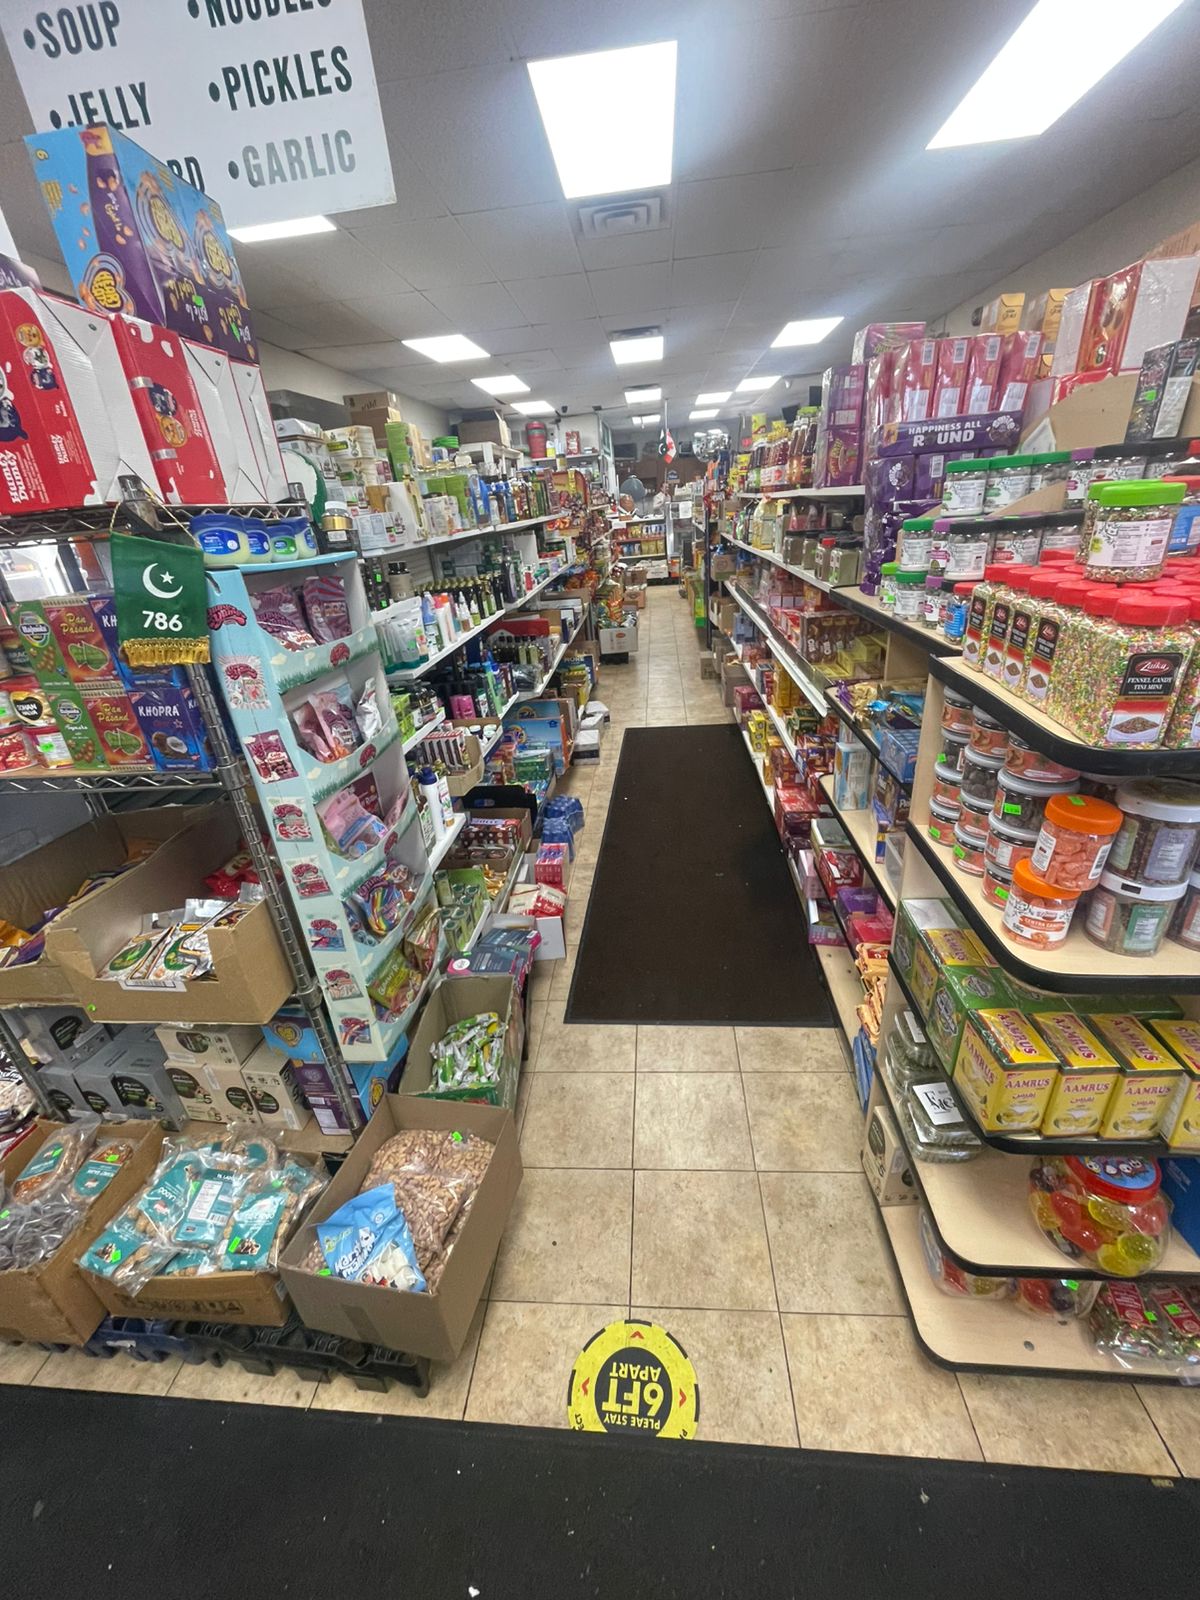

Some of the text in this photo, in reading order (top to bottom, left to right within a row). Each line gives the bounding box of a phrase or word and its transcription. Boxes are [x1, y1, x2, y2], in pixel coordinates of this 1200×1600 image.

[36, 1, 120, 59] SOUP
[222, 45, 353, 111] PICKLES
[242, 129, 356, 189] GARLIC
[908, 420, 982, 435] HAPPINESS ALL
[4, 449, 29, 501] Dumty
[65, 612, 86, 625] Pan
[142, 609, 183, 633] 786
[60, 623, 95, 635] Pasand
[101, 703, 122, 713] Pan
[138, 705, 180, 717] KHOPRA
[96, 712, 129, 722] Pasand
[998, 1013, 1038, 1056] AAMRUS
[964, 1037, 995, 1084] AAMRUS
[1005, 1078, 1050, 1089] AAMRUS
[1064, 1083, 1110, 1094] AAMRUS
[1125, 1086, 1172, 1096] AAMRUS
[609, 1362, 661, 1382] APART
[601, 1378, 665, 1417] 6FT
[603, 1413, 628, 1425] STAY
